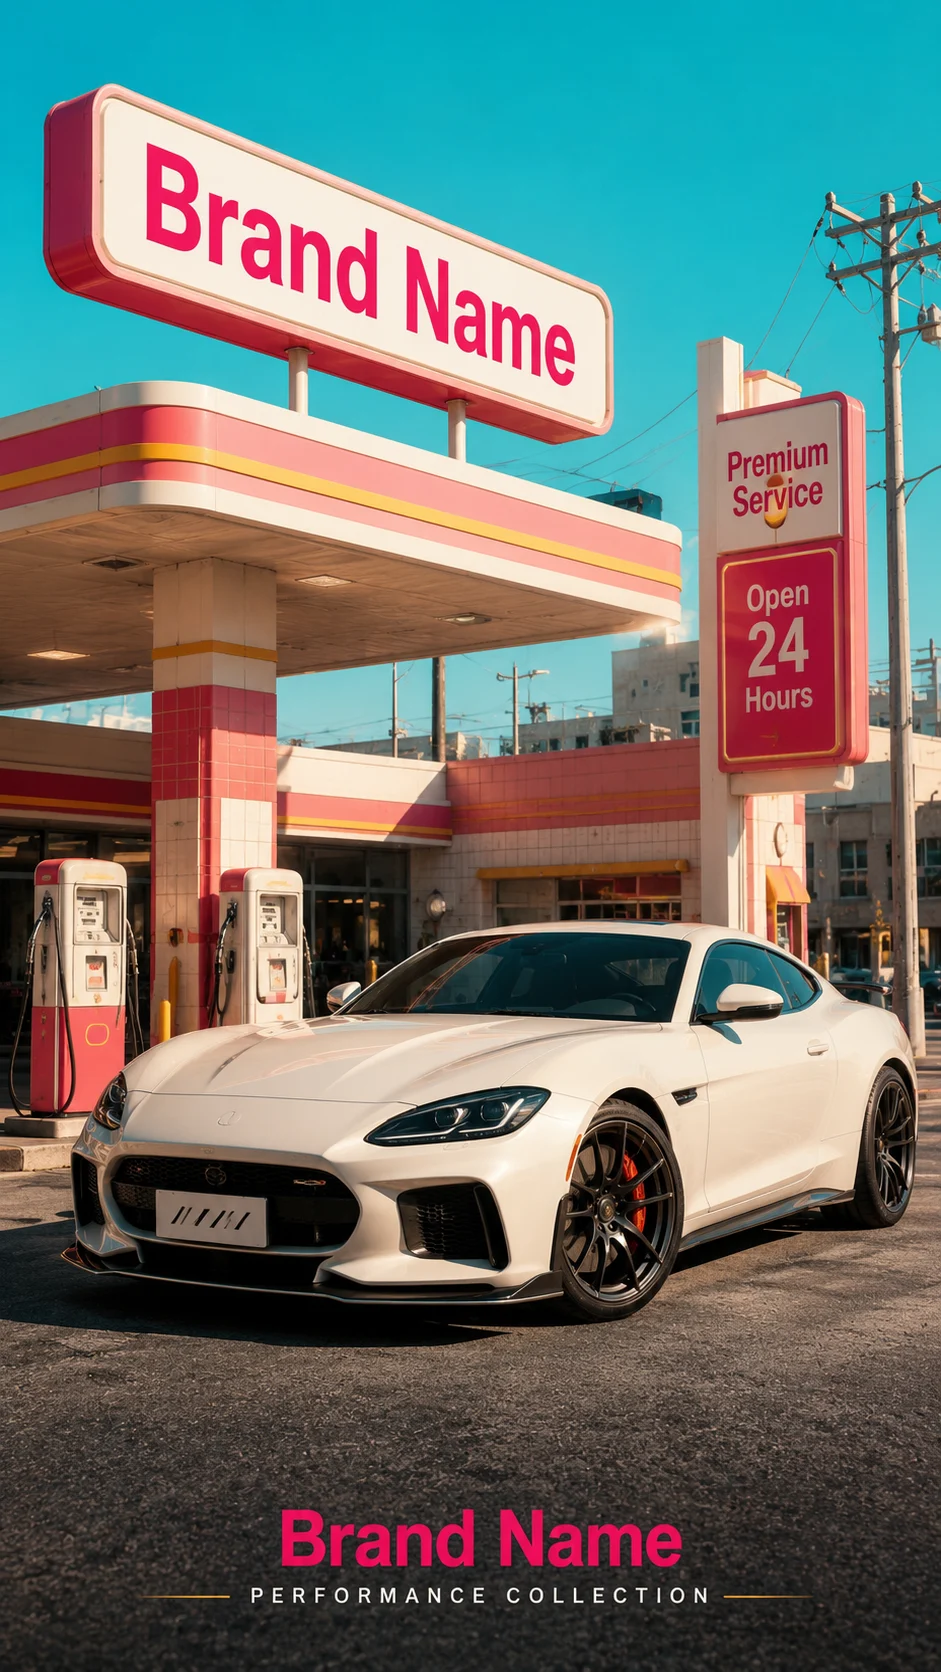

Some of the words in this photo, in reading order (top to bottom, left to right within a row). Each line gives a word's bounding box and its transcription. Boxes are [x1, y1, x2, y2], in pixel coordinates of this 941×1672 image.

[146, 143, 378, 319] Brand
[406, 245, 576, 387] Name
[728, 440, 829, 482] Premium
[732, 477, 824, 518] Service
[746, 584, 809, 617] Open
[748, 616, 809, 679] 24
[745, 685, 813, 714] Hours
